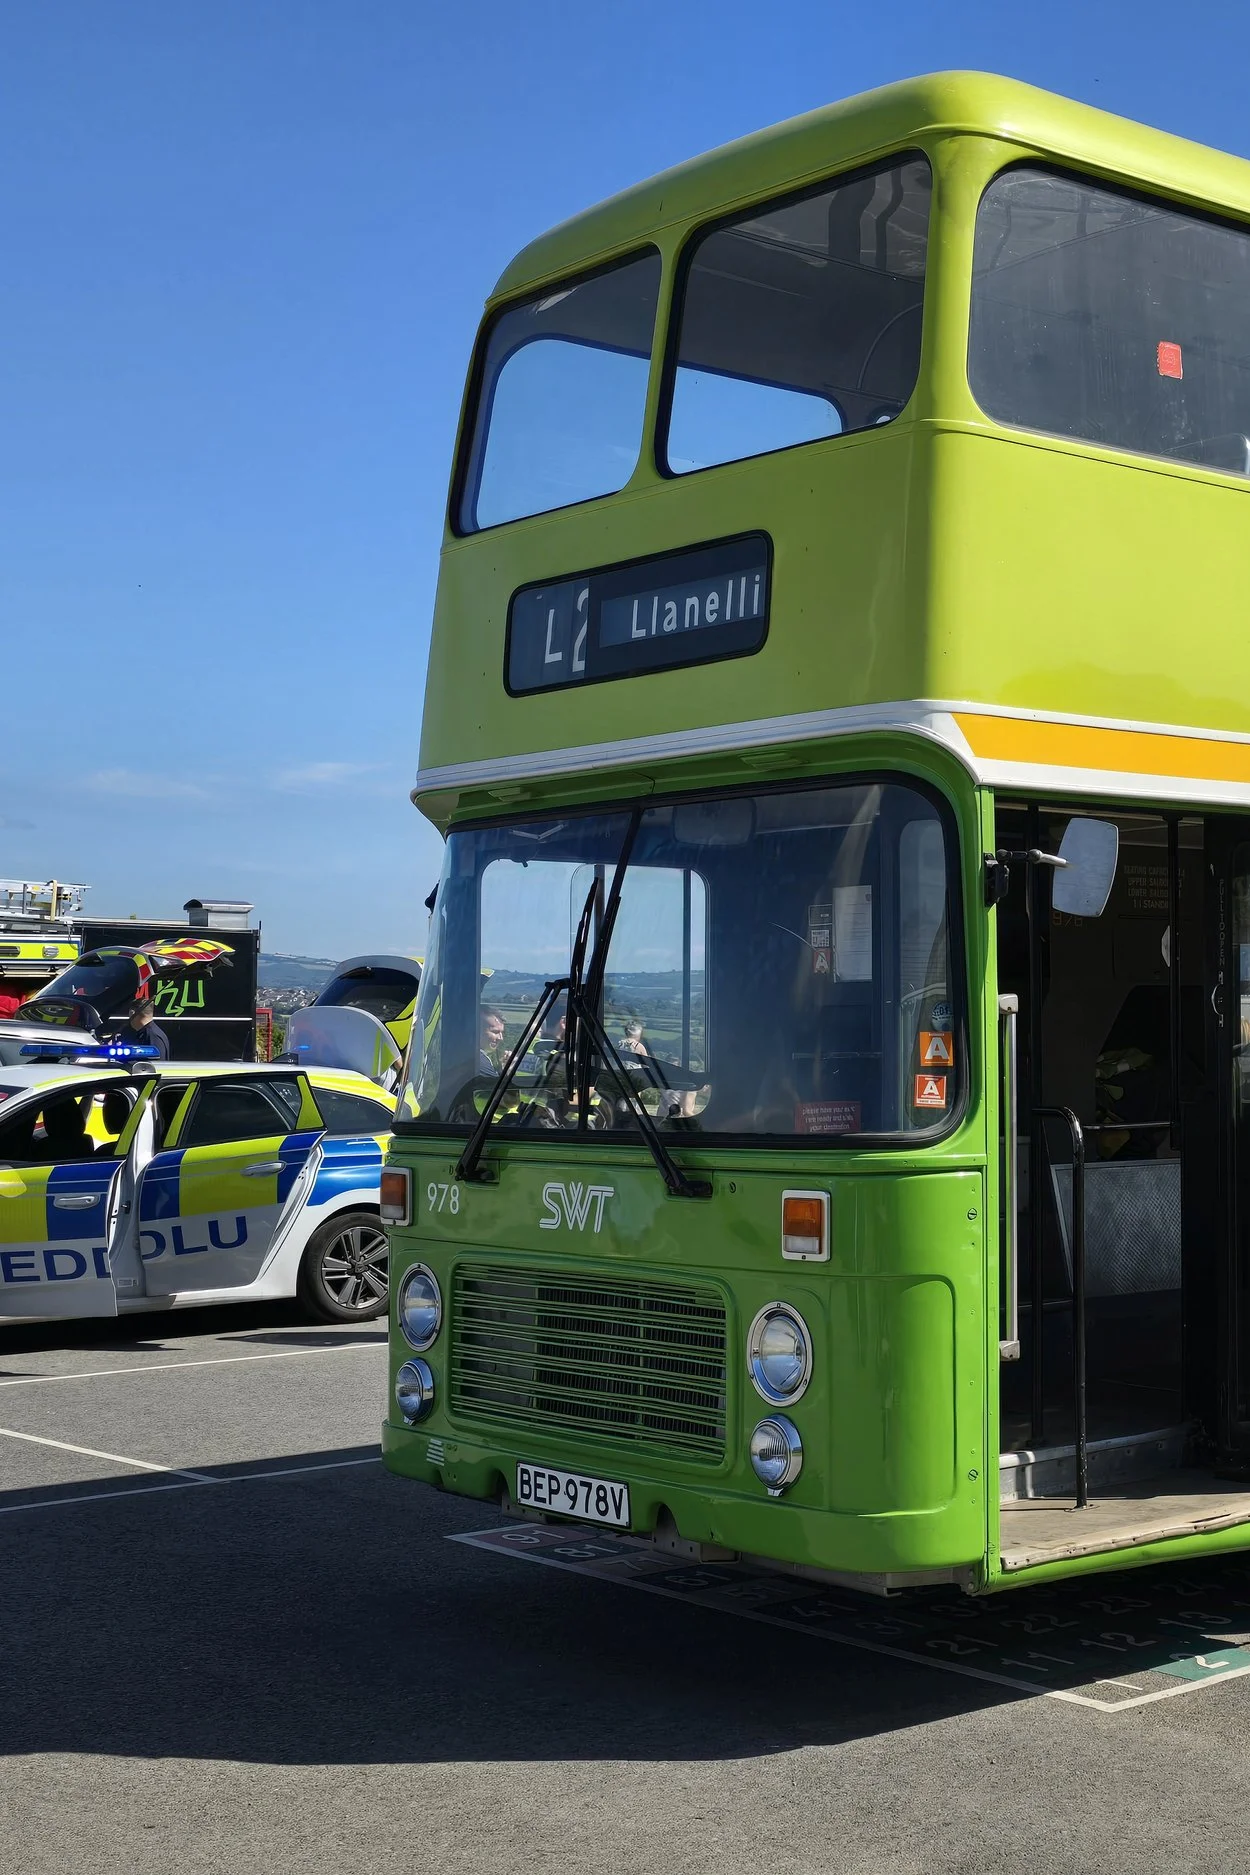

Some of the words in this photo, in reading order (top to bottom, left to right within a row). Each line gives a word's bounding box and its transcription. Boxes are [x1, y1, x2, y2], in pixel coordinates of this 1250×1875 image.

[631, 574, 760, 639] Llanelli
[427, 1182, 460, 1215] 978
[539, 1181, 614, 1233] SWT
